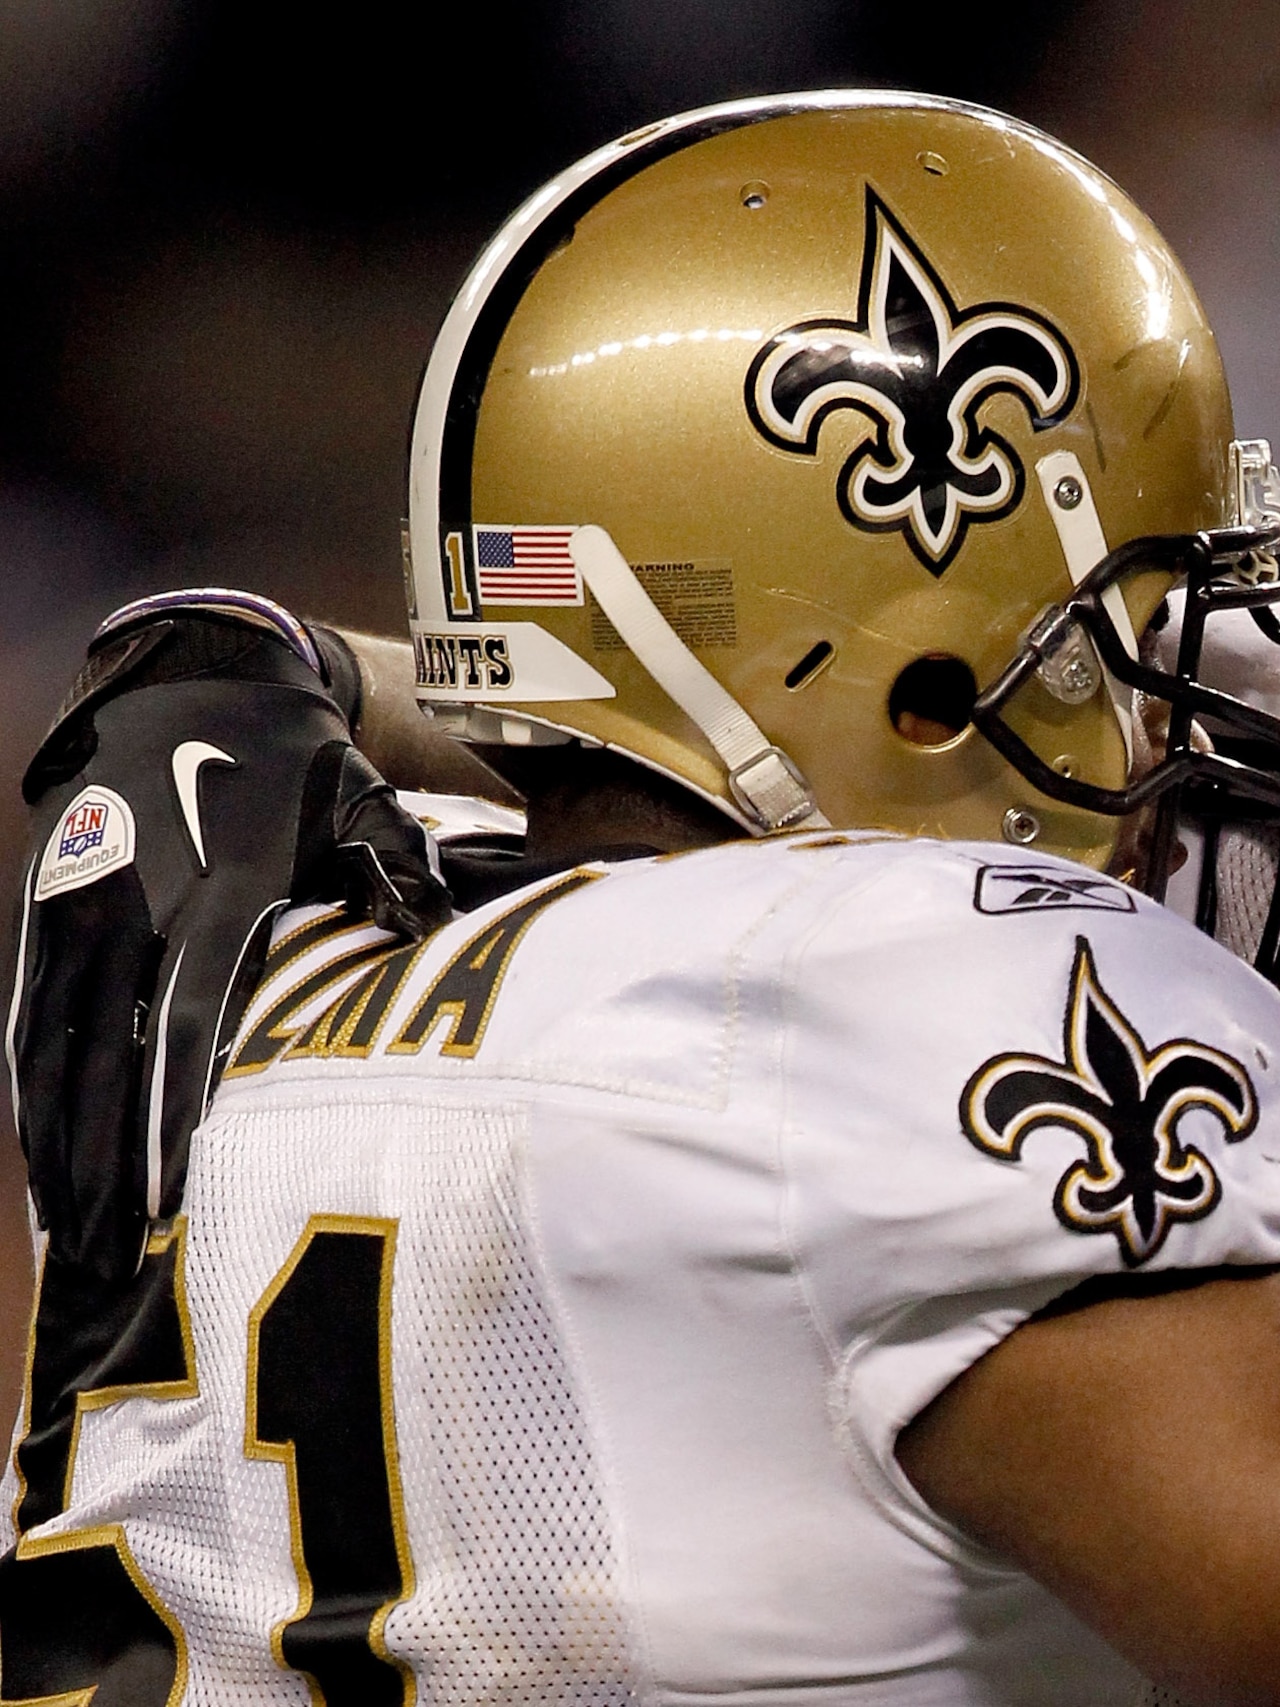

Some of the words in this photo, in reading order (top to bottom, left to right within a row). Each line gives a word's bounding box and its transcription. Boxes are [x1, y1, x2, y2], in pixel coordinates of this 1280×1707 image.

[445, 531, 473, 616] 1
[67, 807, 105, 837] NFL
[41, 844, 121, 886] EQUIPMENT
